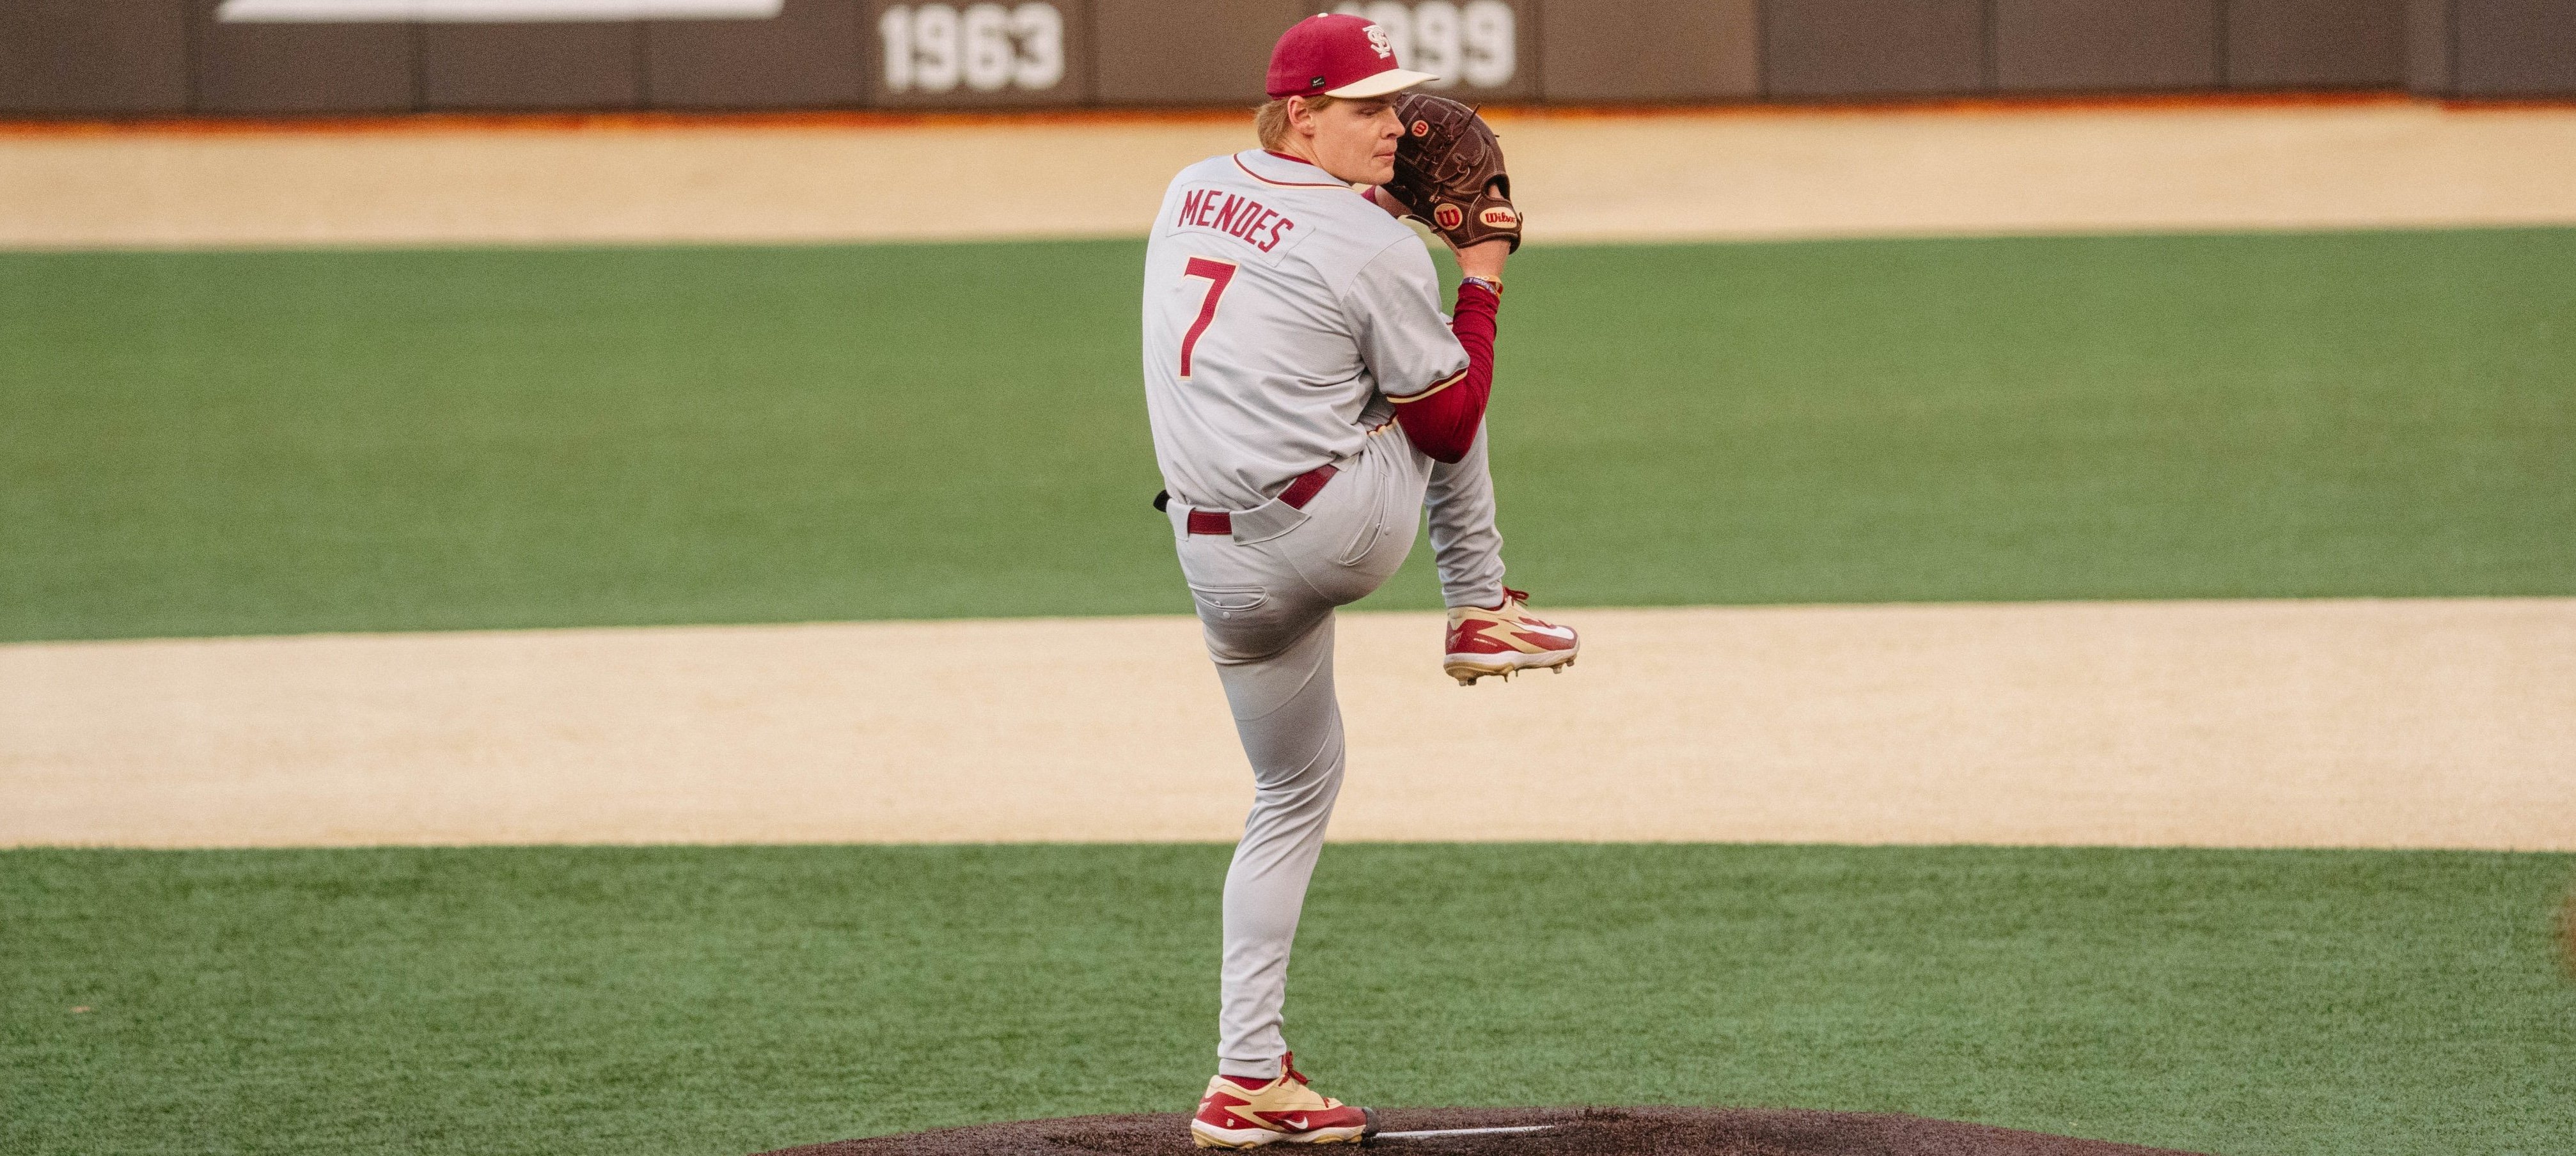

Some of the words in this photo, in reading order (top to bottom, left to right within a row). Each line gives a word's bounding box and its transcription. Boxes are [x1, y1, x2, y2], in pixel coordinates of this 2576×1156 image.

[880, 3, 1065, 89] 1963
[1337, 3, 1514, 86] 999
[1178, 189, 1294, 253] MENDES
[1178, 254, 1240, 380] 7
